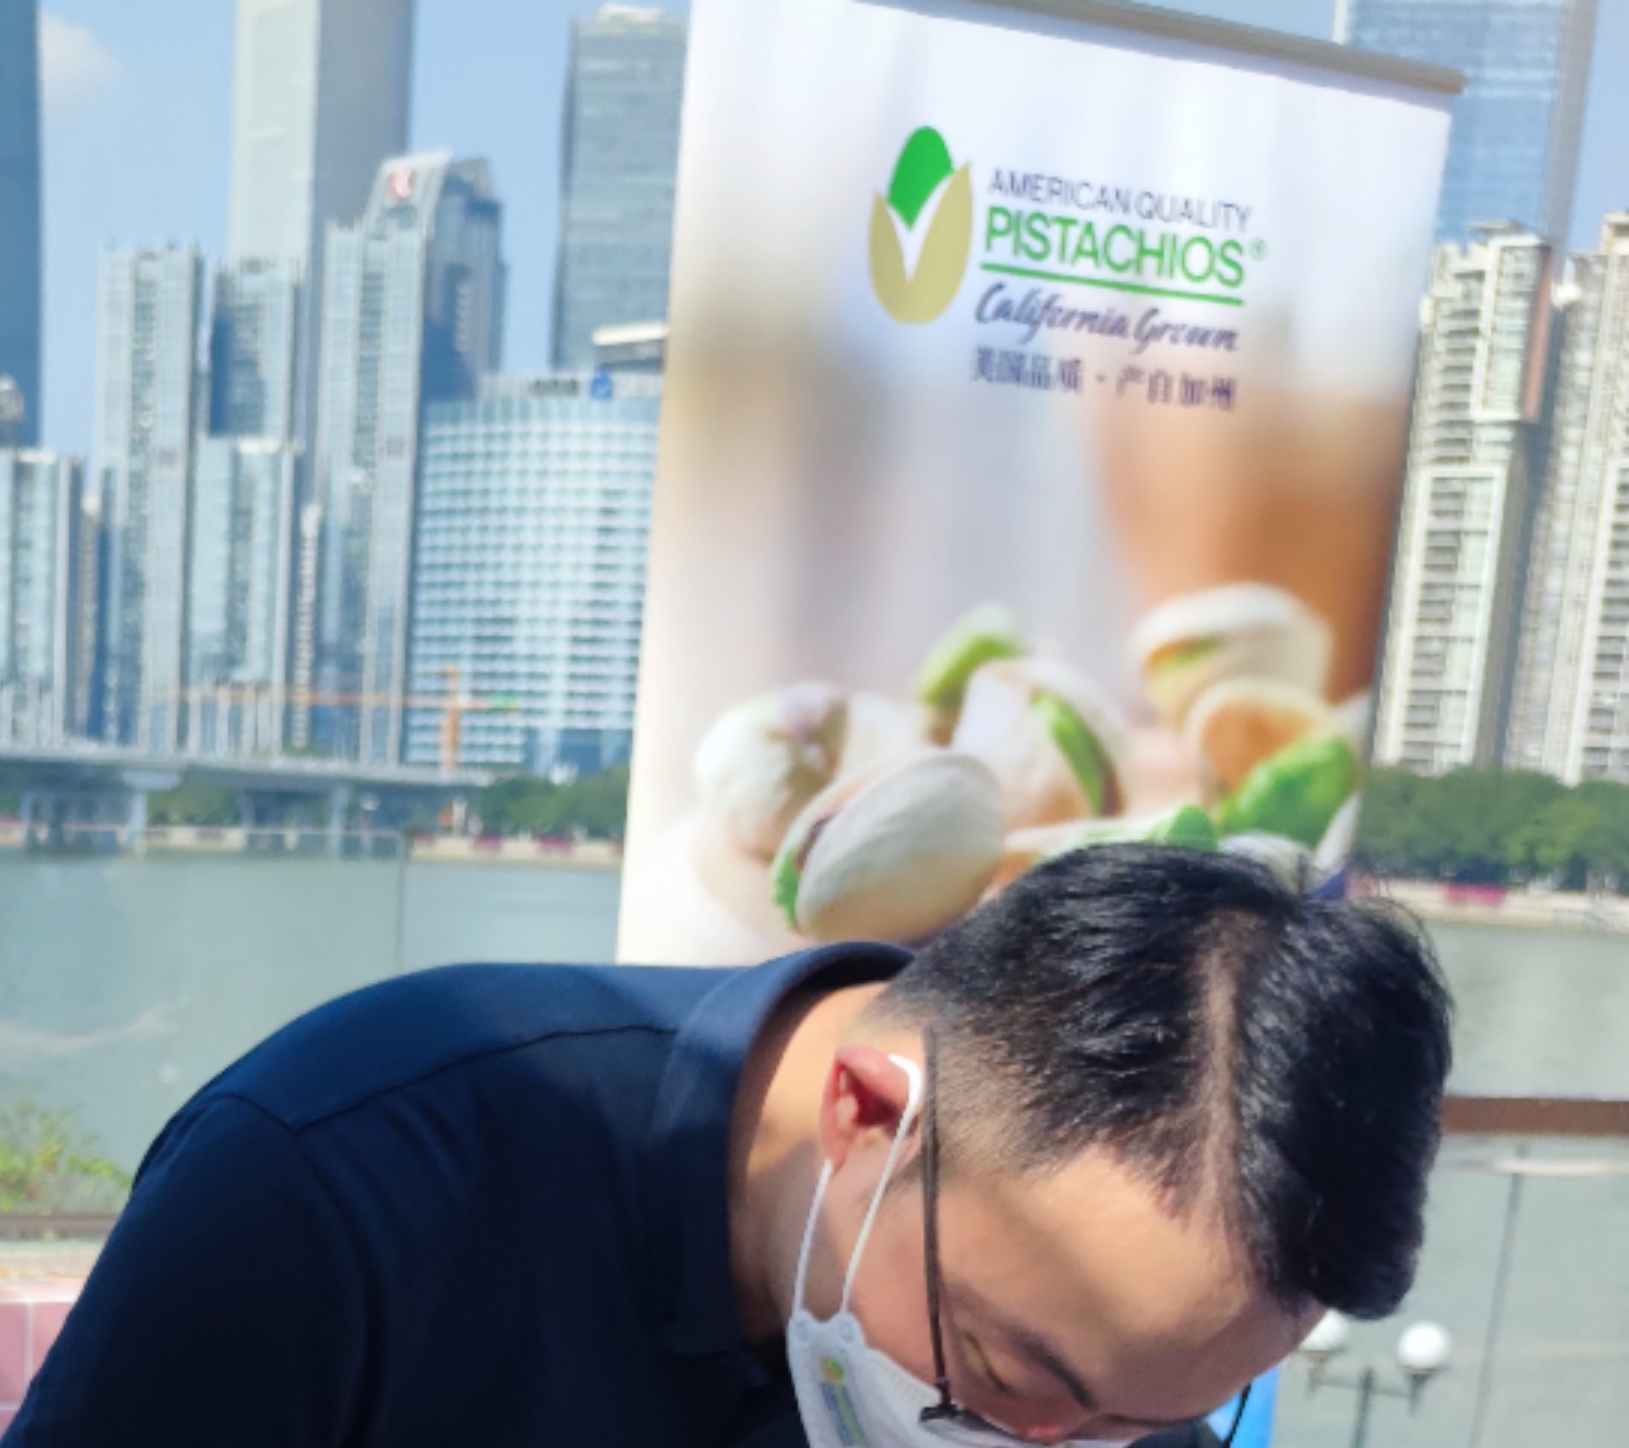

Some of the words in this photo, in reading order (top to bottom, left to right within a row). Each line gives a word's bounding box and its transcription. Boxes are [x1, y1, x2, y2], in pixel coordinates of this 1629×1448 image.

[988, 168, 1130, 213] AMERICAN
[1136, 191, 1251, 232] QUALITY
[975, 281, 1129, 346] California
[1132, 307, 1240, 355] Grown
